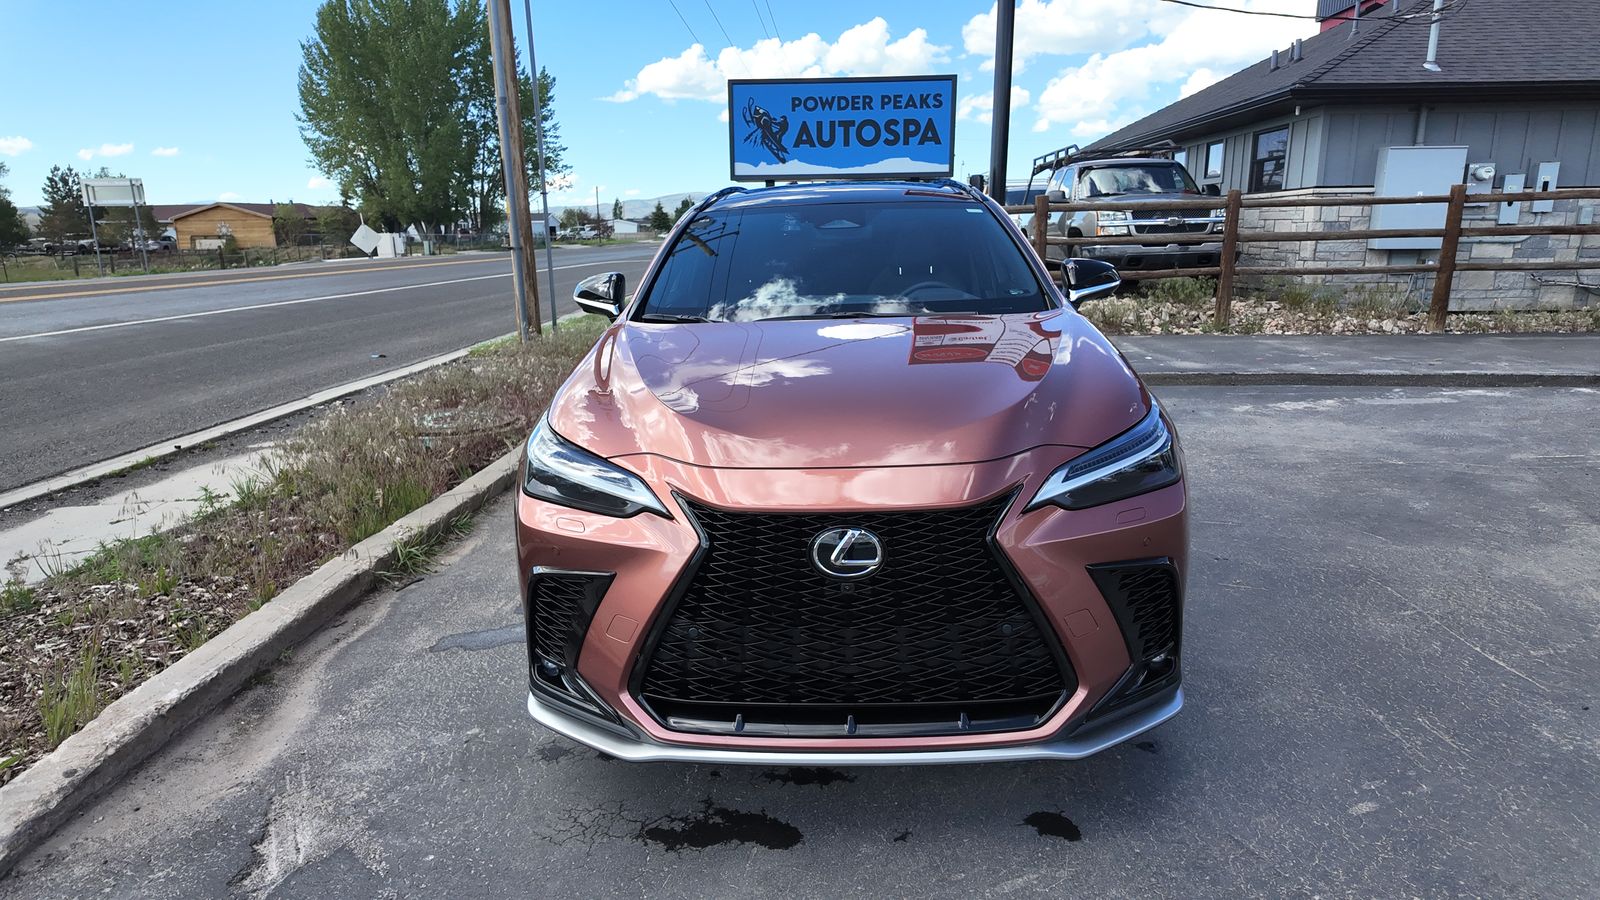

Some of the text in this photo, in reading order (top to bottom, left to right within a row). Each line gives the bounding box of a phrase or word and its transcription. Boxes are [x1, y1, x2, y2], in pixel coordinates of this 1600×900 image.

[791, 93, 944, 112] POWDER PEAKS
[792, 118, 942, 148] AUTOSPA
